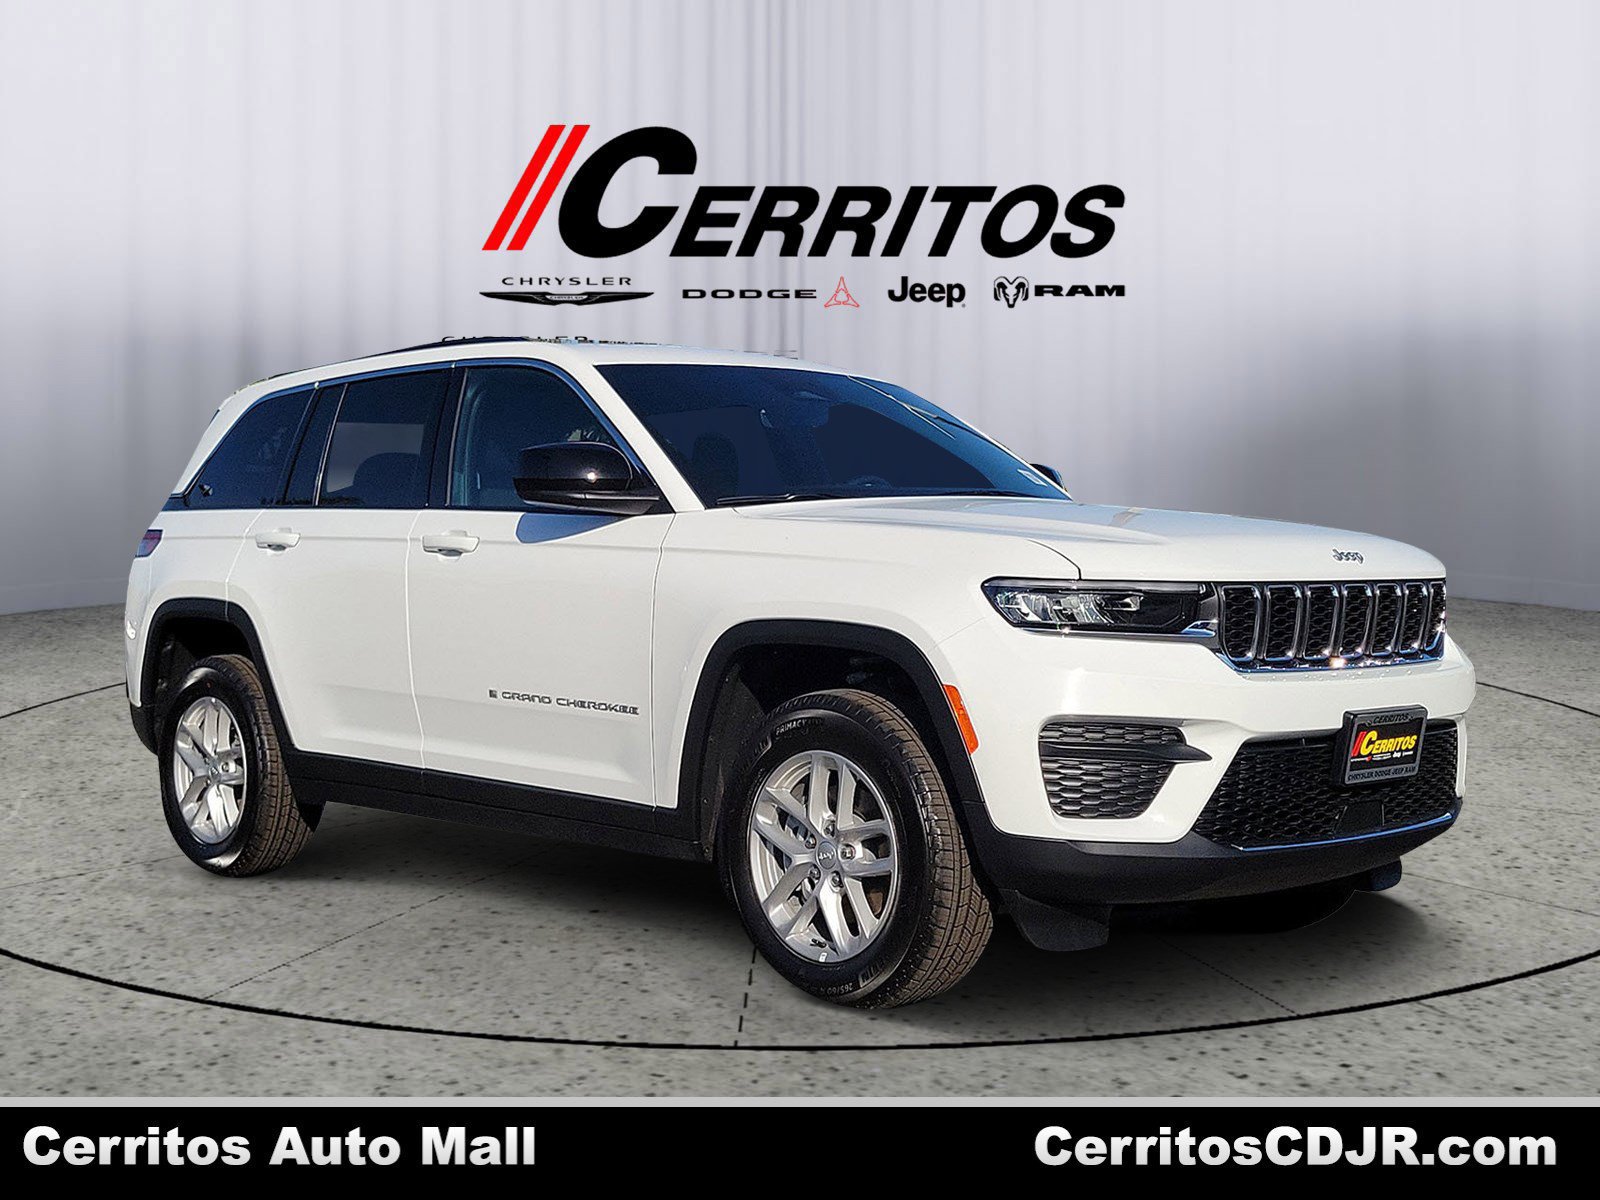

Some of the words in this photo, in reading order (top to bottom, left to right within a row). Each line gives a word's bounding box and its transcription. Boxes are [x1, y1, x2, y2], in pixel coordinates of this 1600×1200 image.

[1331, 548, 1364, 565] Jeep
[501, 691, 552, 704] GRAND
[556, 697, 640, 716] CHEROKEE
[1373, 713, 1409, 724] CERRITOS
[1360, 730, 1418, 756] CERRITOS
